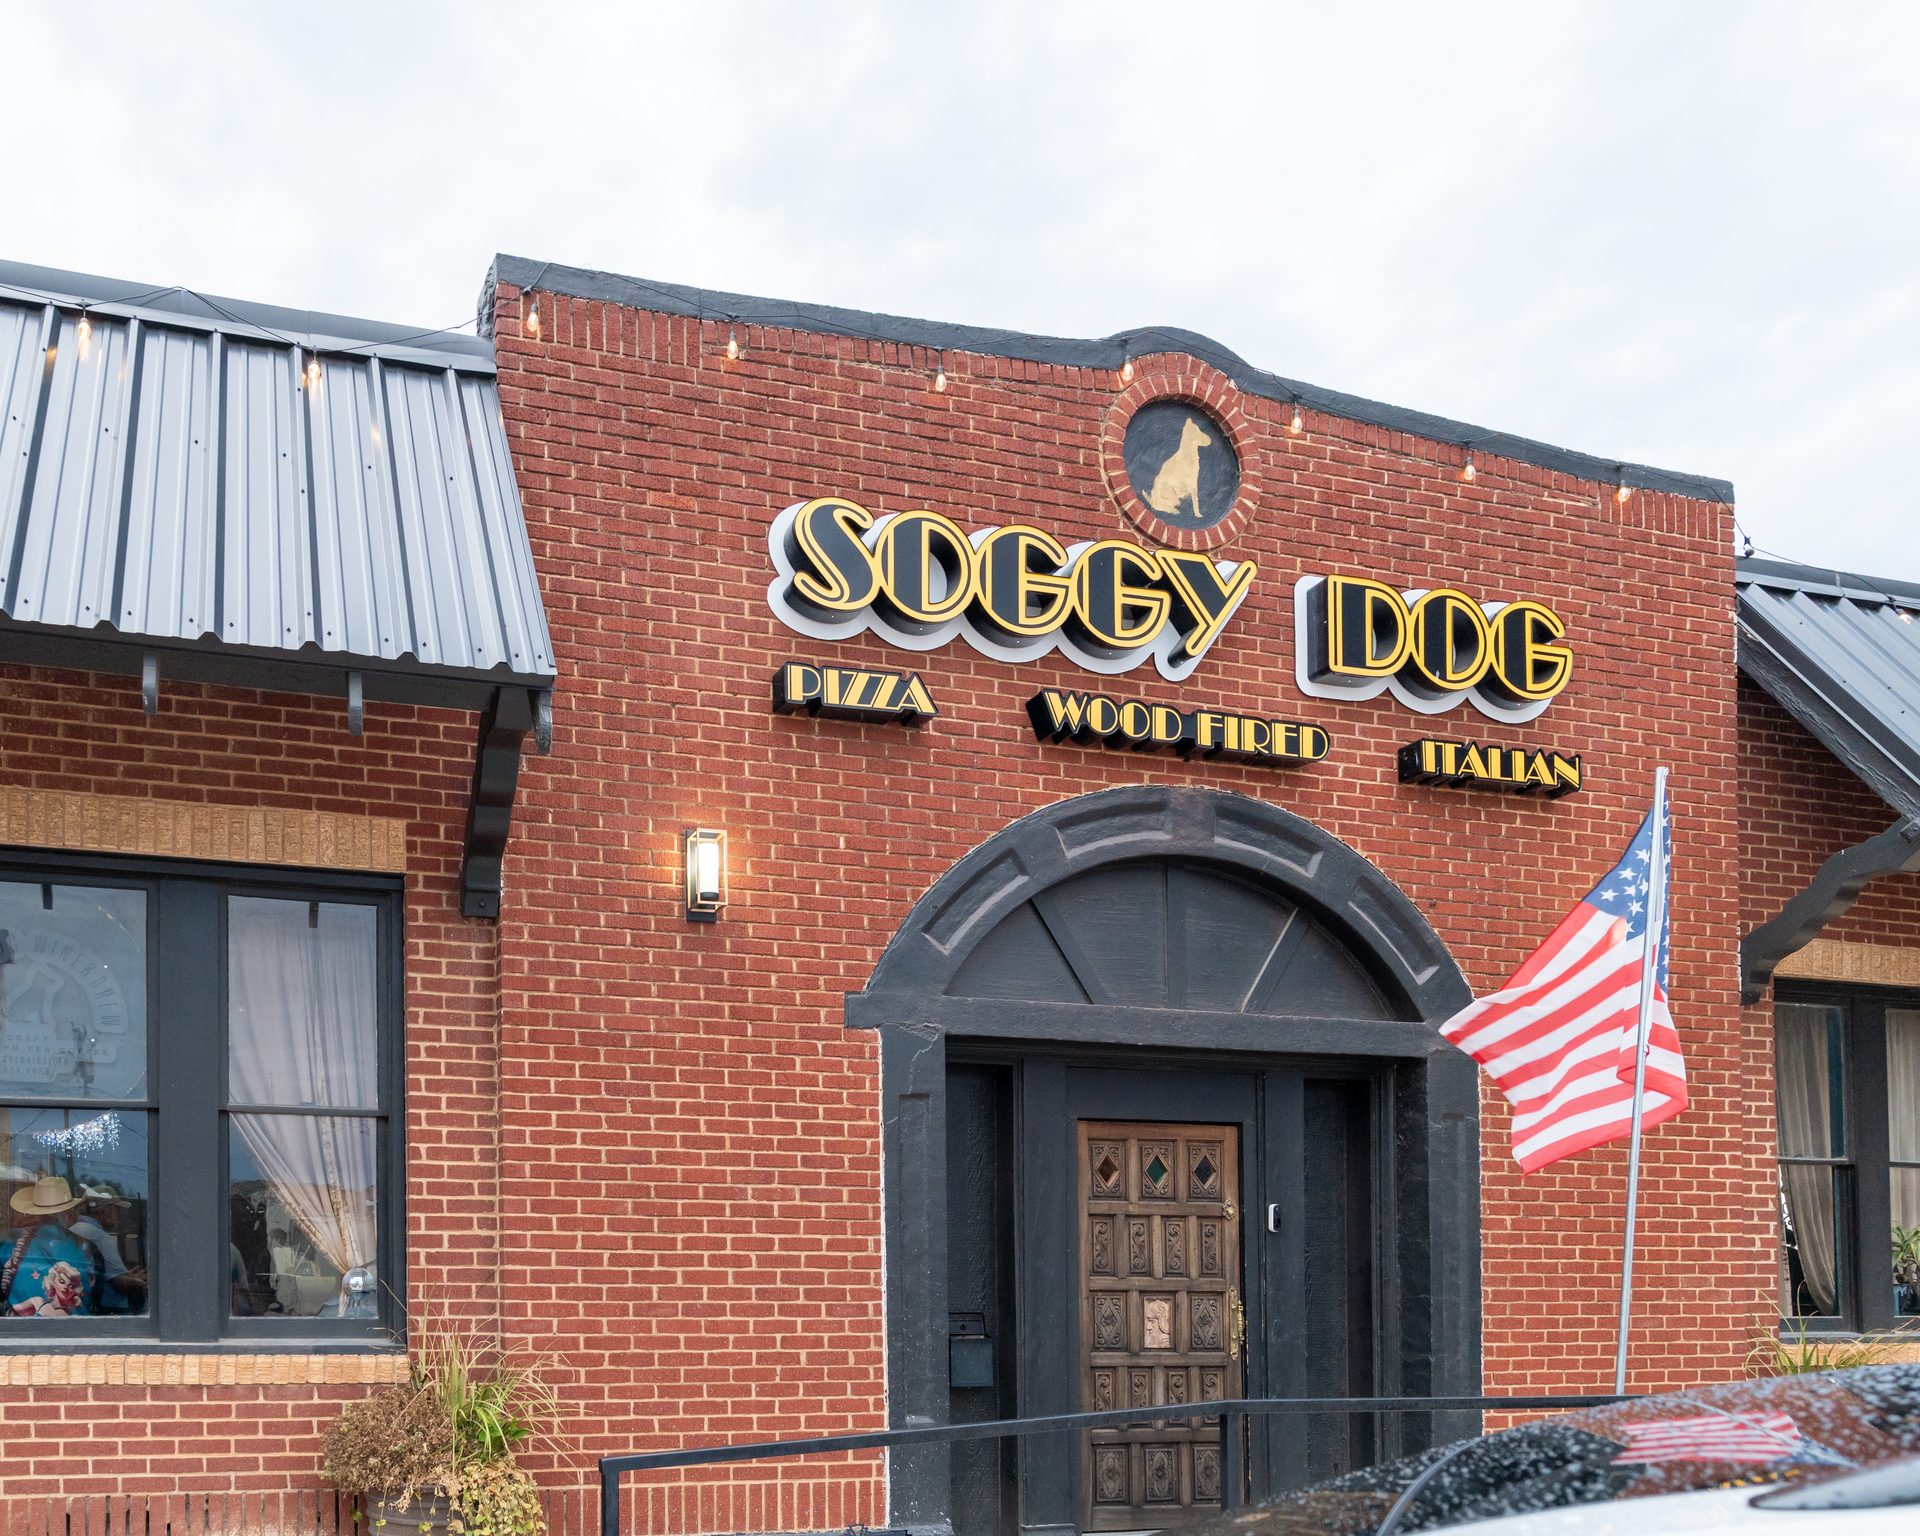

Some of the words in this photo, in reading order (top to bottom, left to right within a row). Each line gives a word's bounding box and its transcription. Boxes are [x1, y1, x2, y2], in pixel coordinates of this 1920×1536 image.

[794, 496, 1258, 658] SOGGY
[1328, 574, 1574, 700] DOG
[787, 664, 937, 714] PIZZA
[1044, 691, 1182, 741] WOOD
[1196, 712, 1329, 760] FIRED
[1422, 740, 1580, 788] ITALIAN
